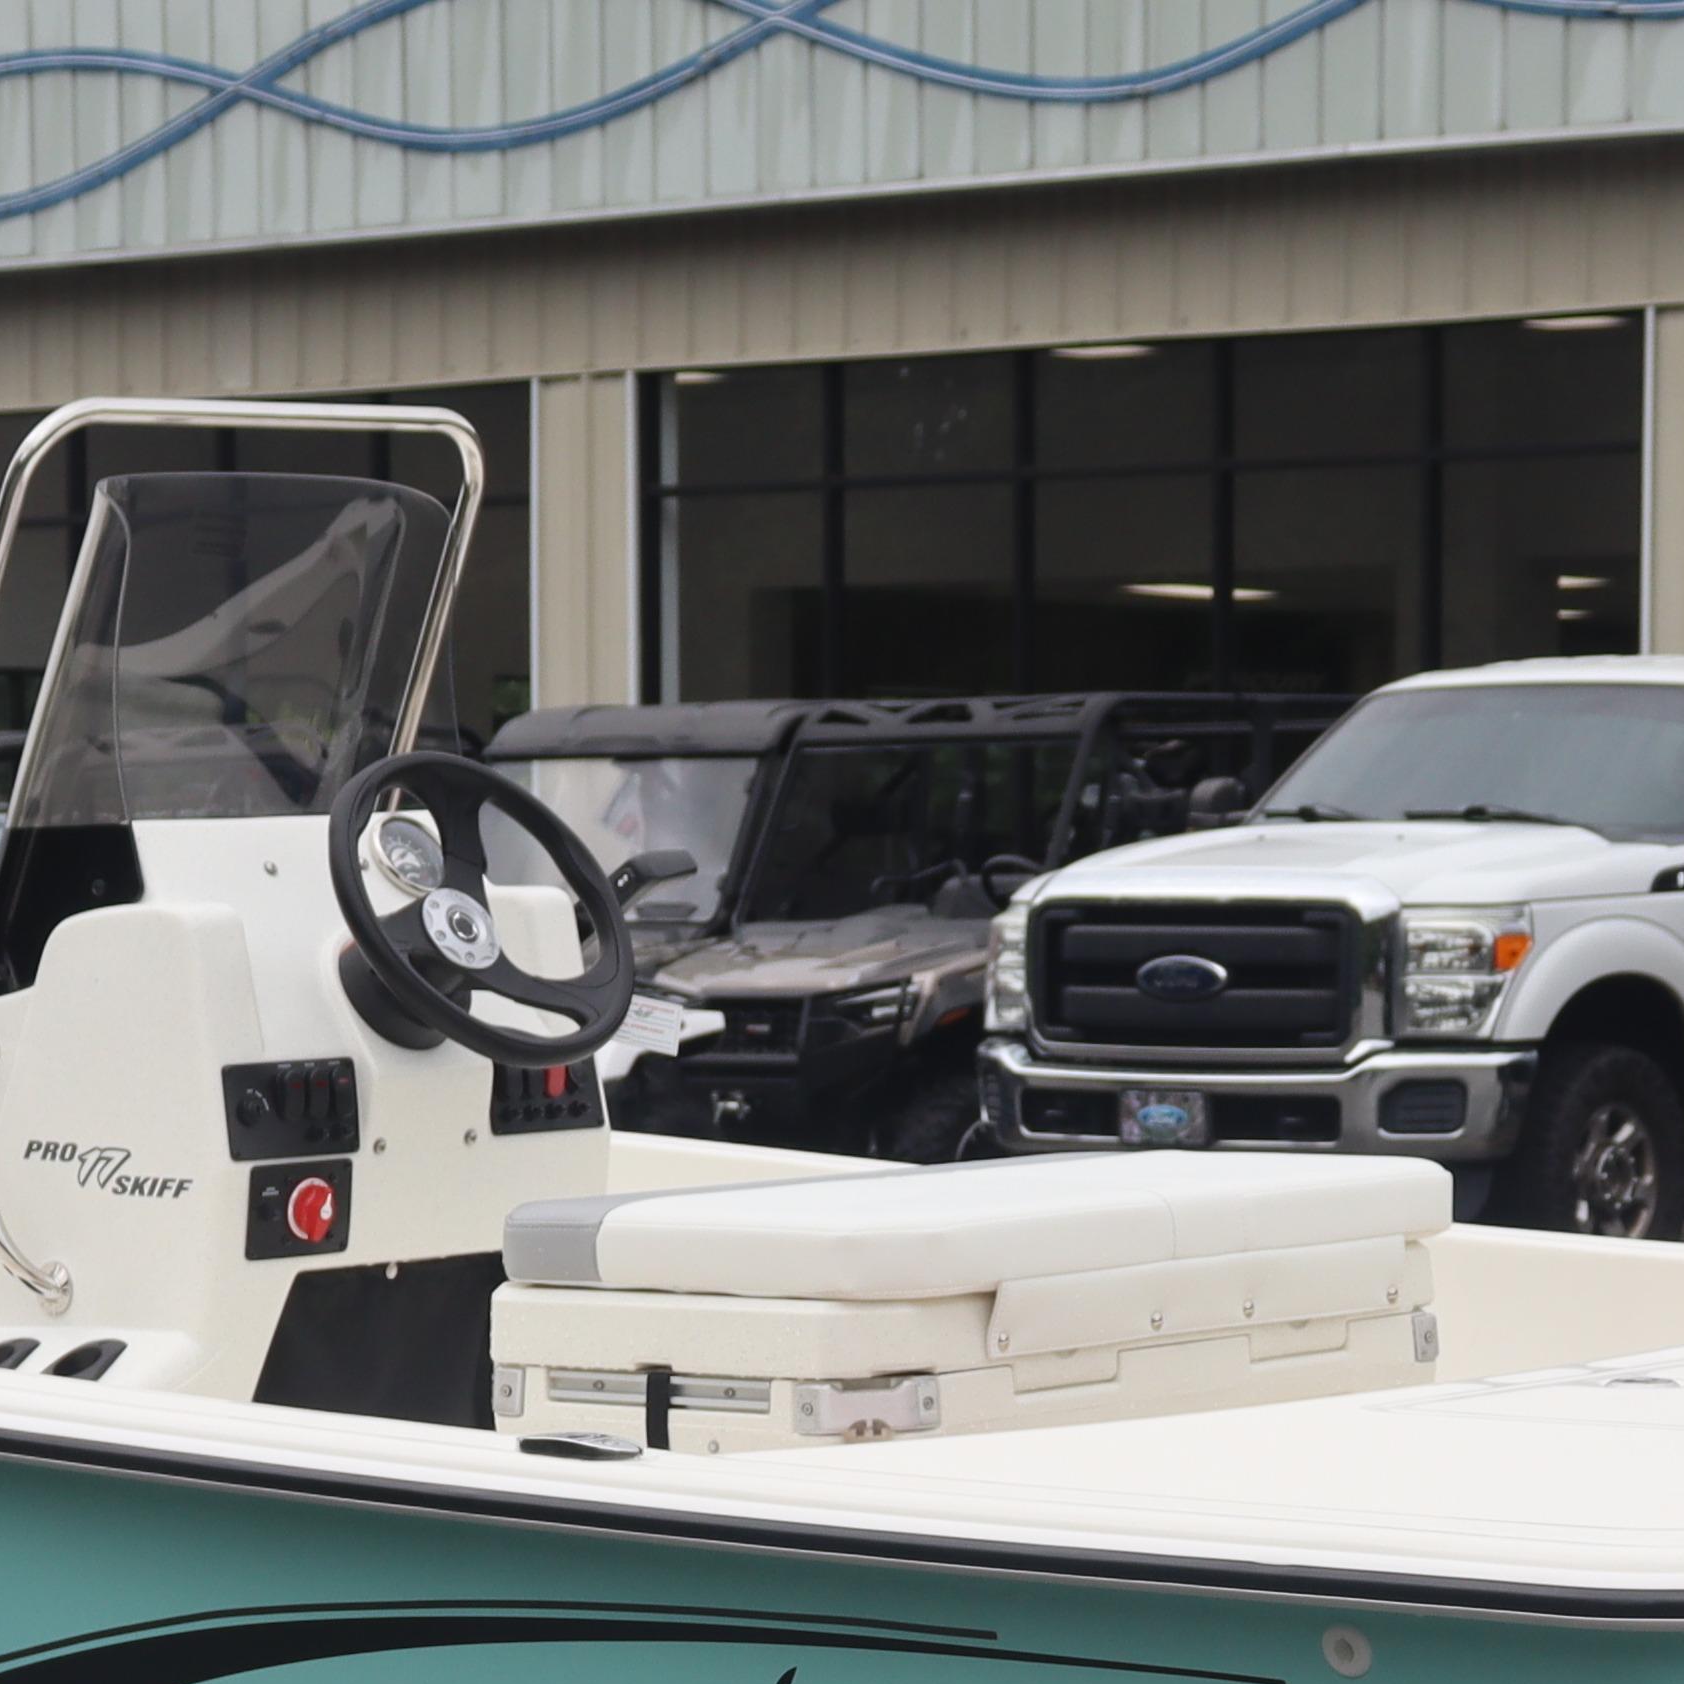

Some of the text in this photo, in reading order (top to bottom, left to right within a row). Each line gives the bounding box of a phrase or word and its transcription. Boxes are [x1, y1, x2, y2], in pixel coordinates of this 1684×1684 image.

[23, 1139, 193, 1198] PRO 17 SKIFF
